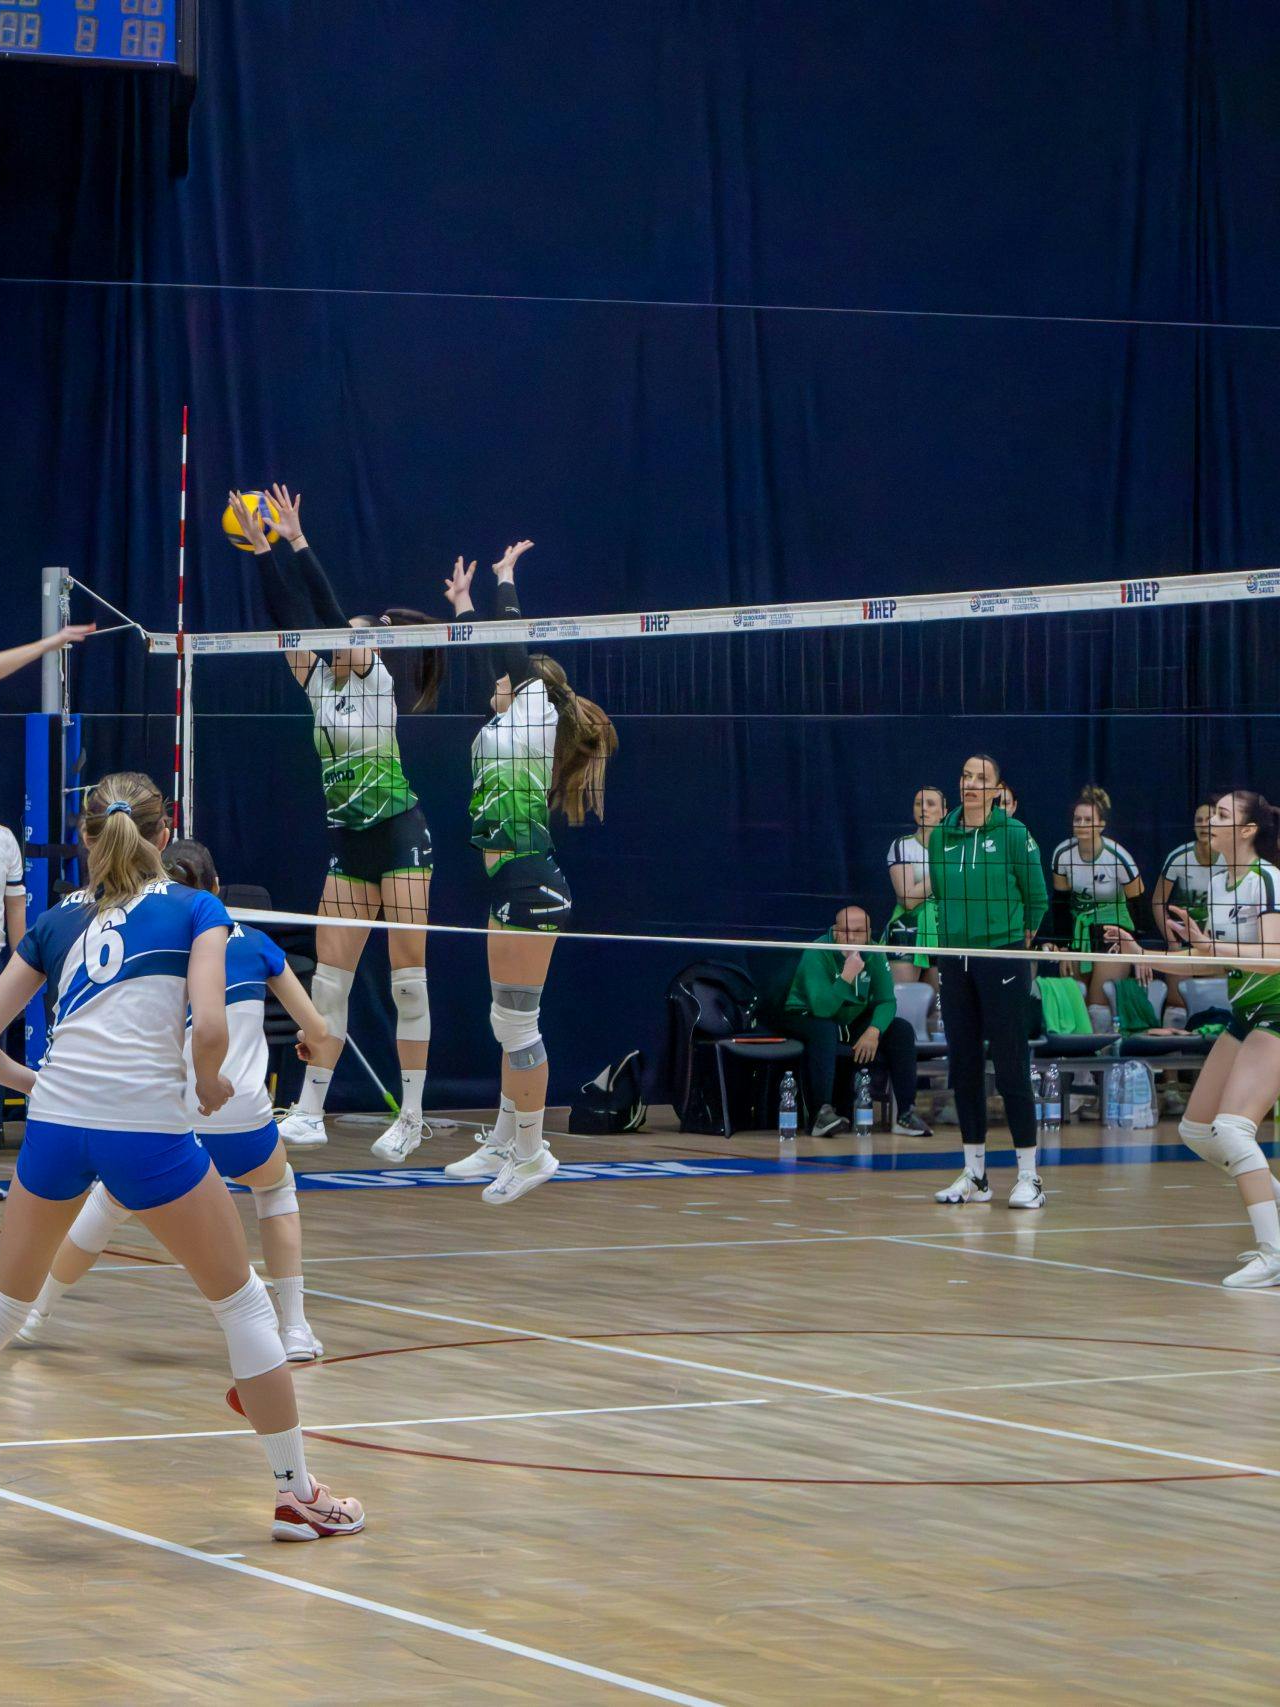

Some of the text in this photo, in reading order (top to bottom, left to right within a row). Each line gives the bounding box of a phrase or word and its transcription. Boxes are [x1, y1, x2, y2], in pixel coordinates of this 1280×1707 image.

[1133, 581, 1160, 602] HEP
[873, 600, 897, 619] HEP
[650, 614, 670, 631] HEP
[285, 633, 301, 648] HEP
[455, 625, 473, 641] HEP
[497, 902, 511, 922] 4
[84, 907, 127, 984] 6
[300, 1162, 754, 1187] OSEK
